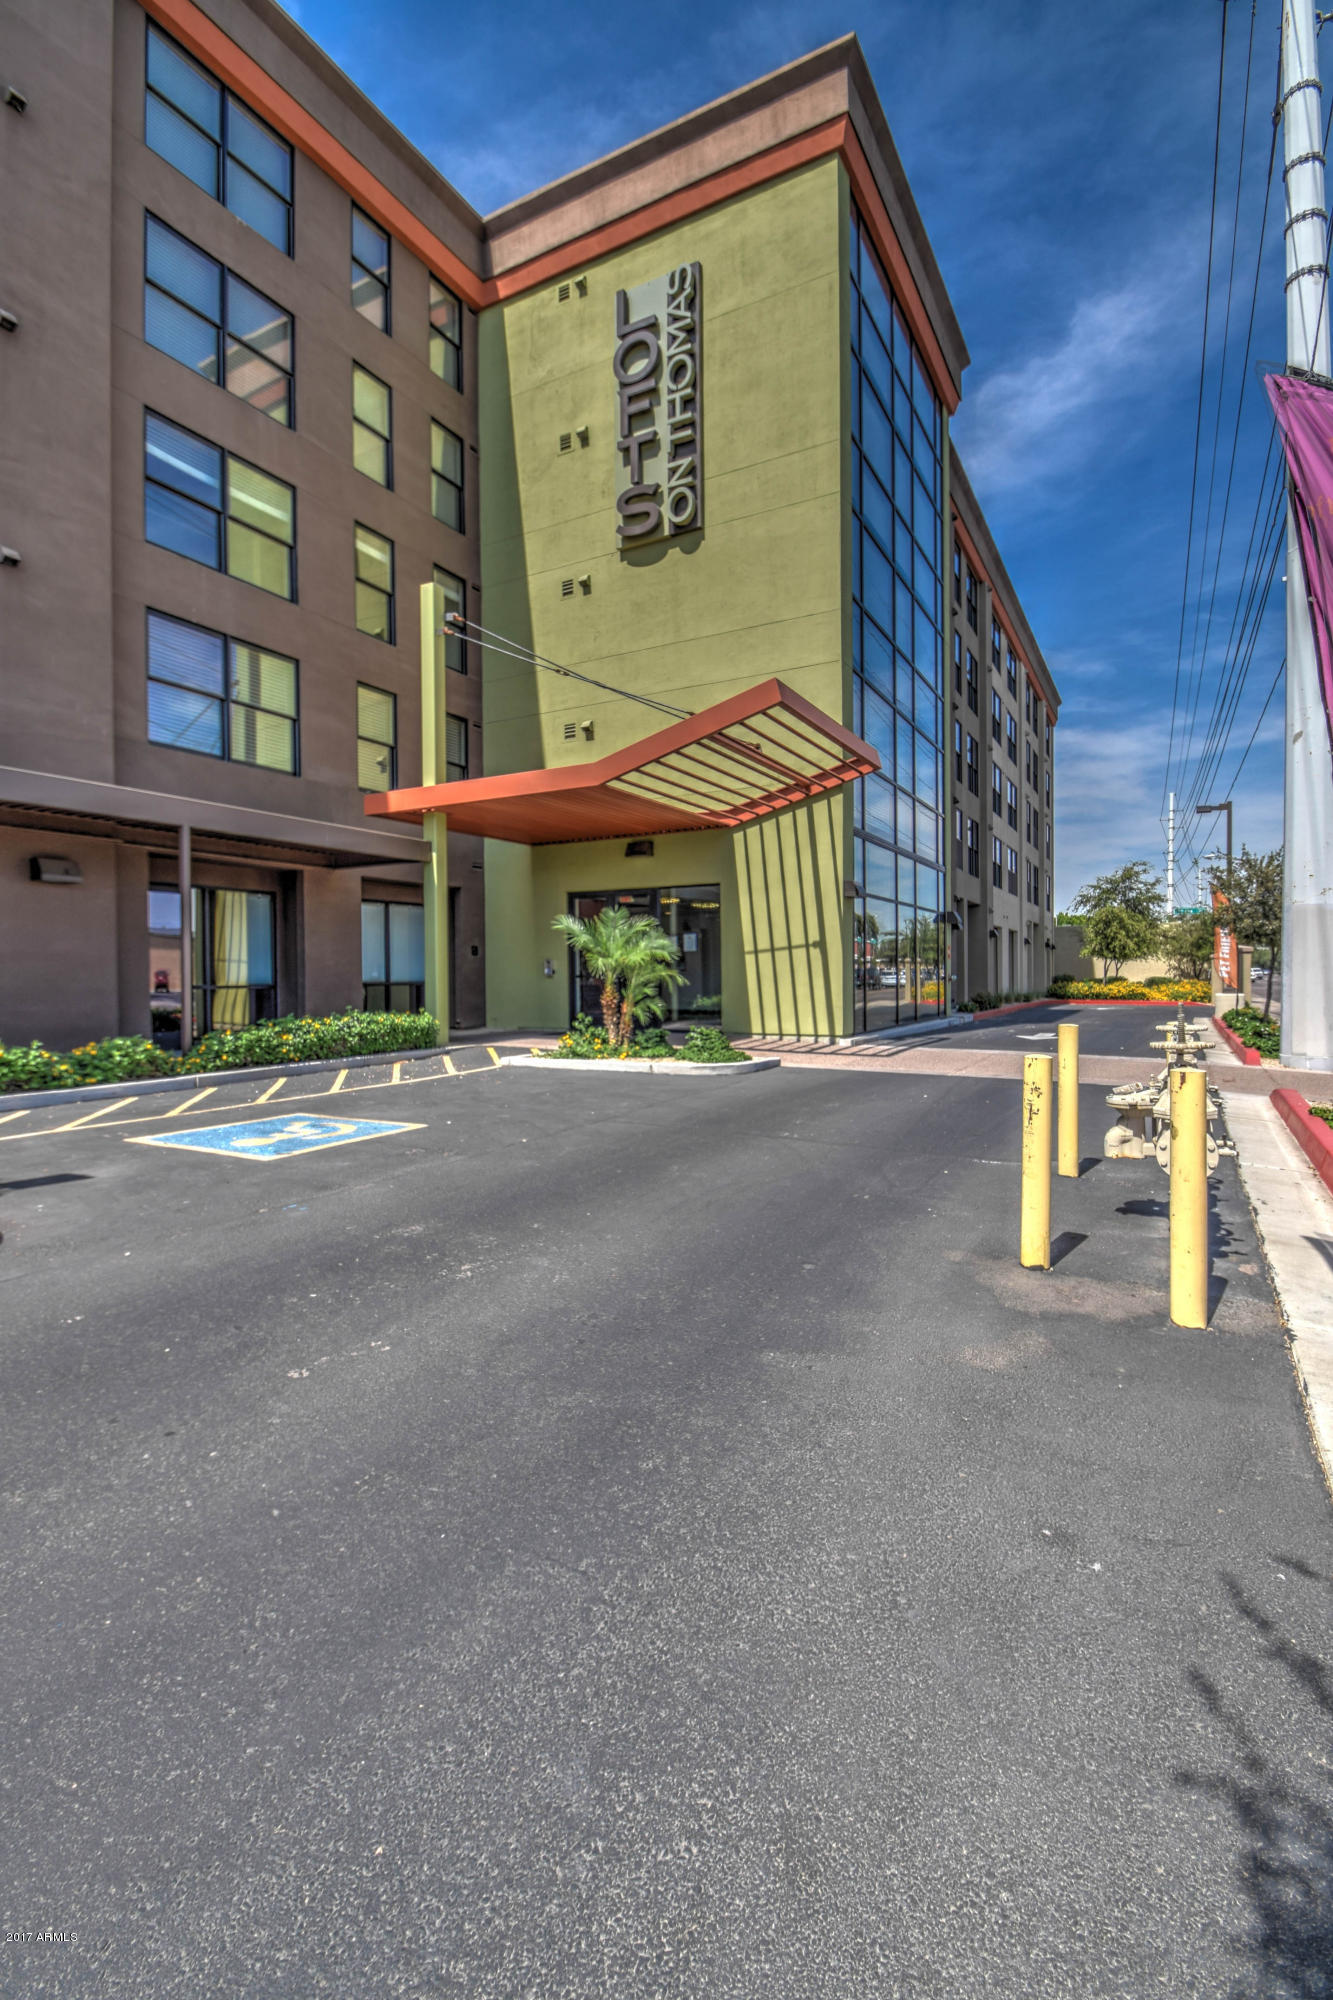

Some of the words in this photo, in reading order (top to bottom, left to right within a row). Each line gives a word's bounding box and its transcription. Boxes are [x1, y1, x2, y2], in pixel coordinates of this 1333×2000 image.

[613, 289, 660, 537] LOFTS
[667, 262, 695, 457] THOMAS
[667, 457, 696, 526] ON
[1219, 960, 1230, 978] PET
